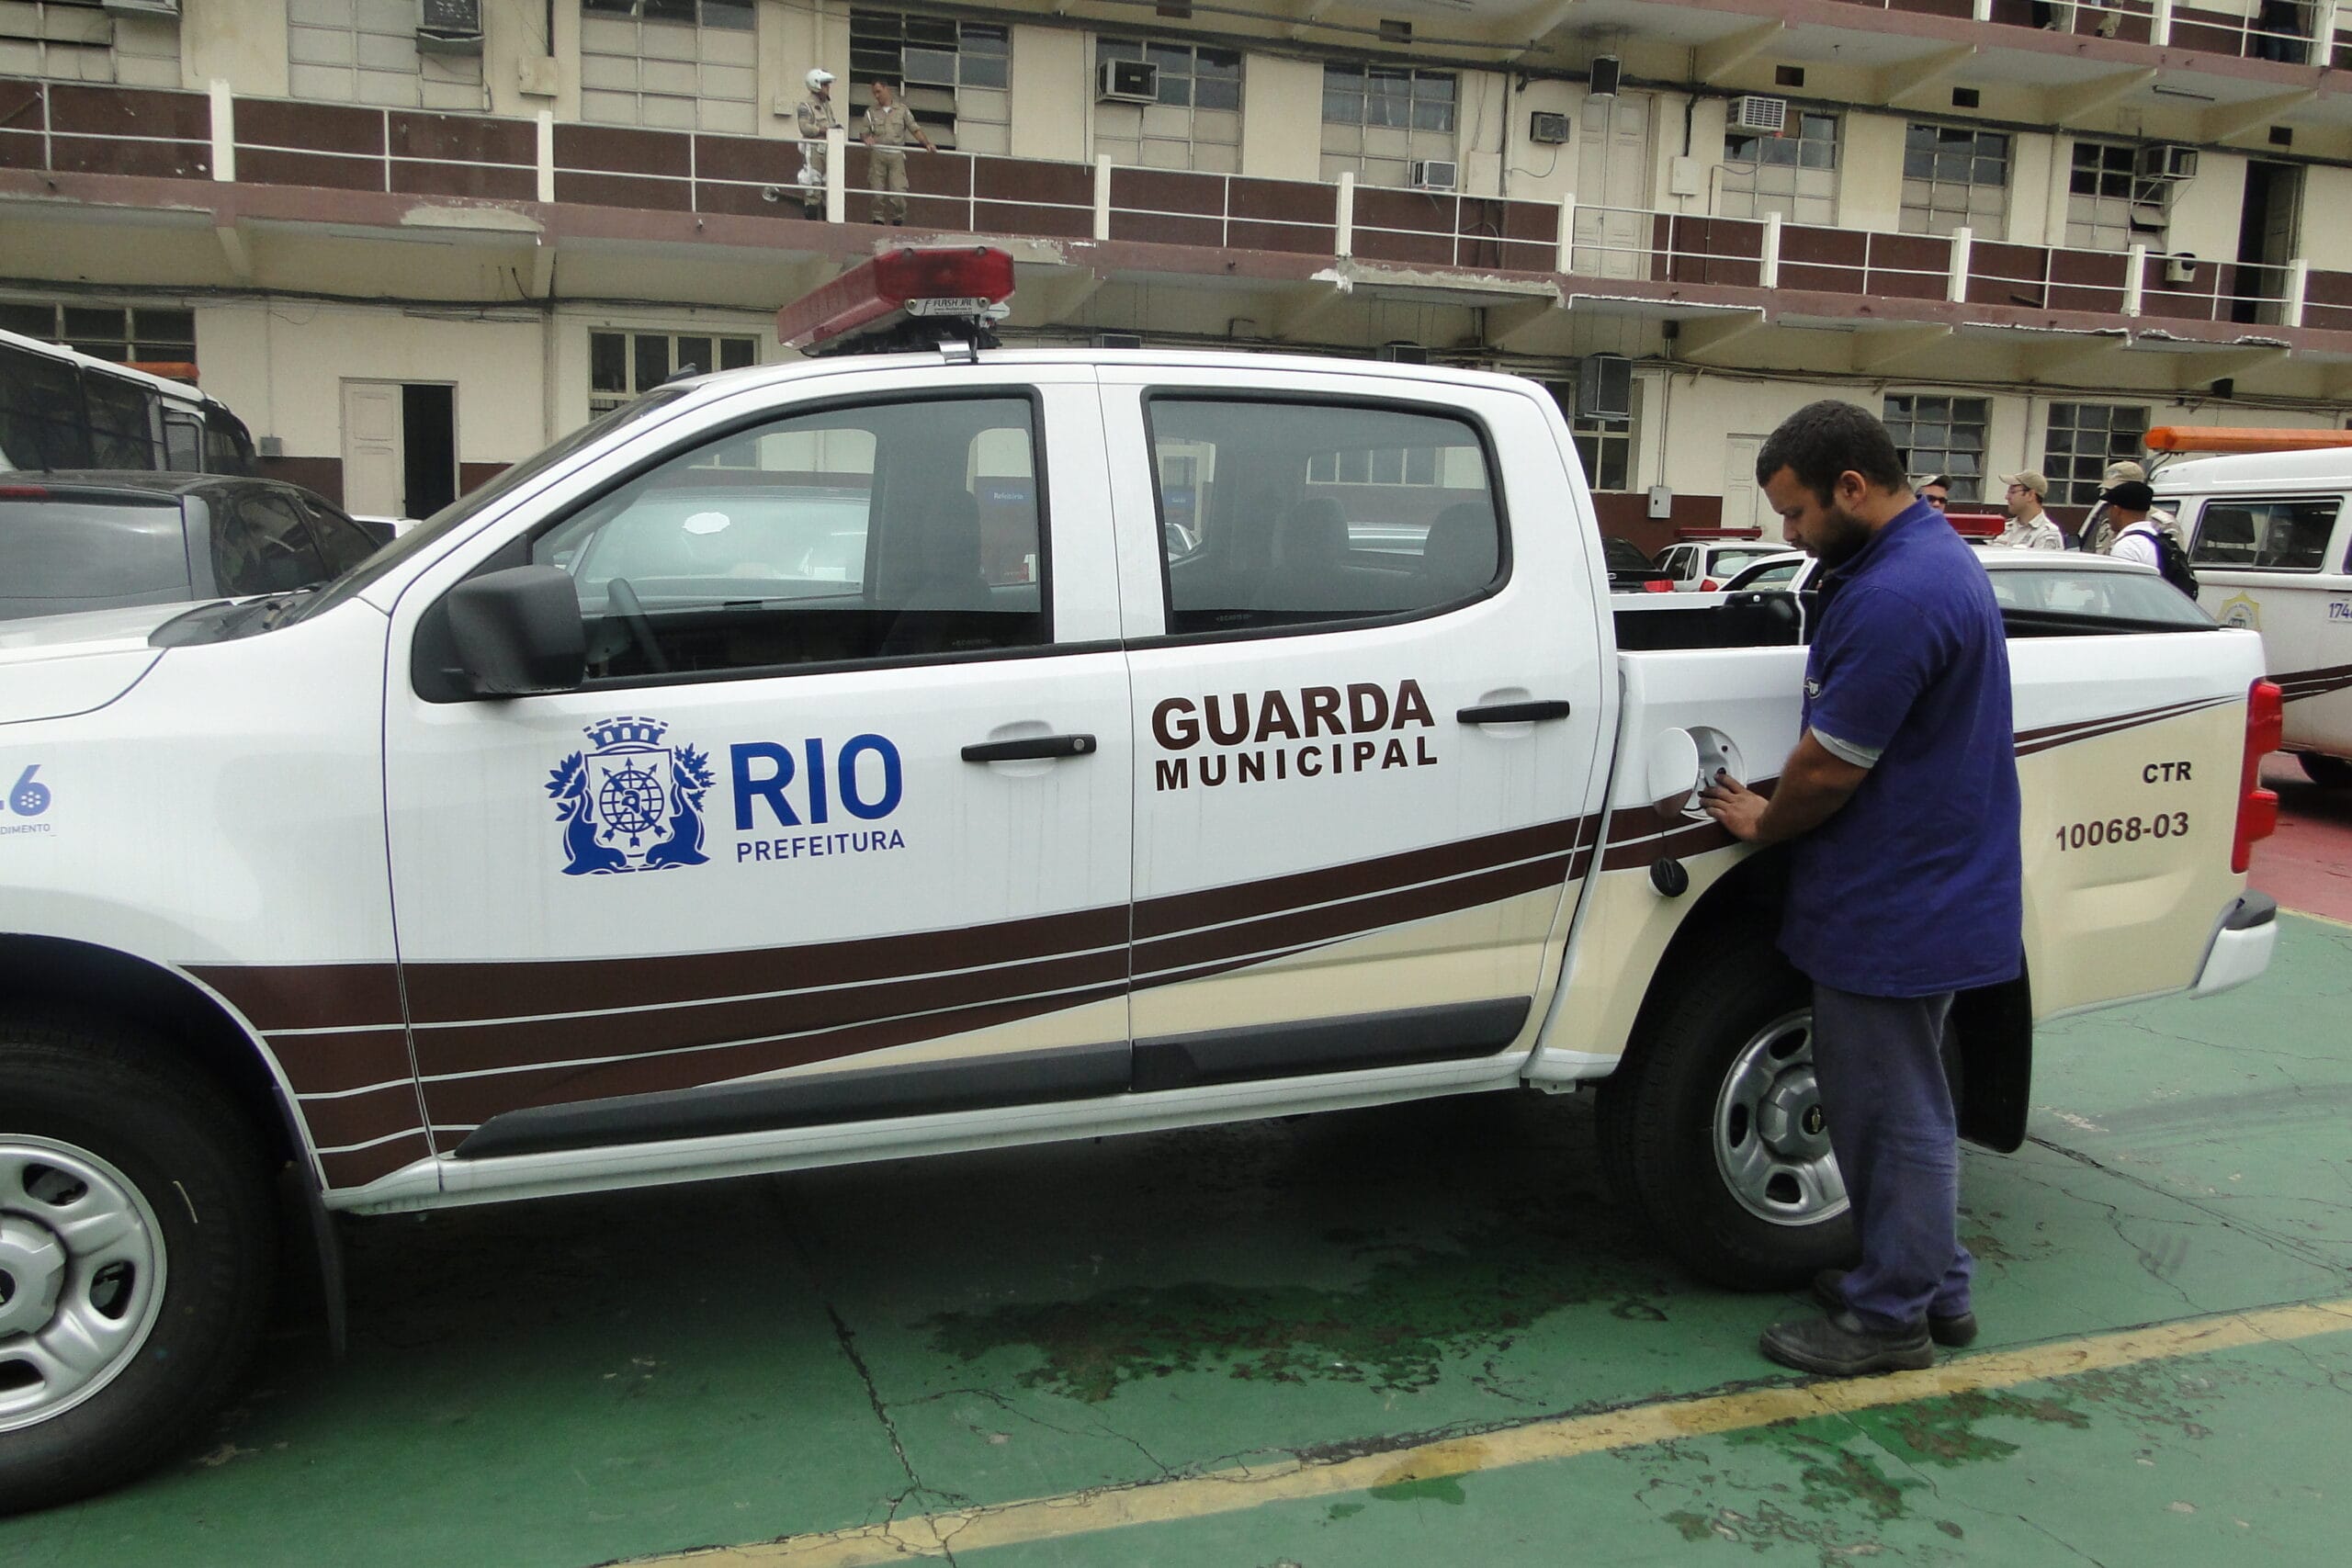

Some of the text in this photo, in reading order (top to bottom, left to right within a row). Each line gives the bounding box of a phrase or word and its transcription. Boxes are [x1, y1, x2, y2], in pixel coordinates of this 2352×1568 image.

[1151, 679, 1436, 751] GUARDA
[729, 733, 902, 831] RIO
[1155, 736, 1438, 791] MUNICIPAL
[2143, 761, 2192, 784] CTR
[737, 829, 906, 863] PREFEITURA
[2055, 811, 2189, 852] 10068-03
